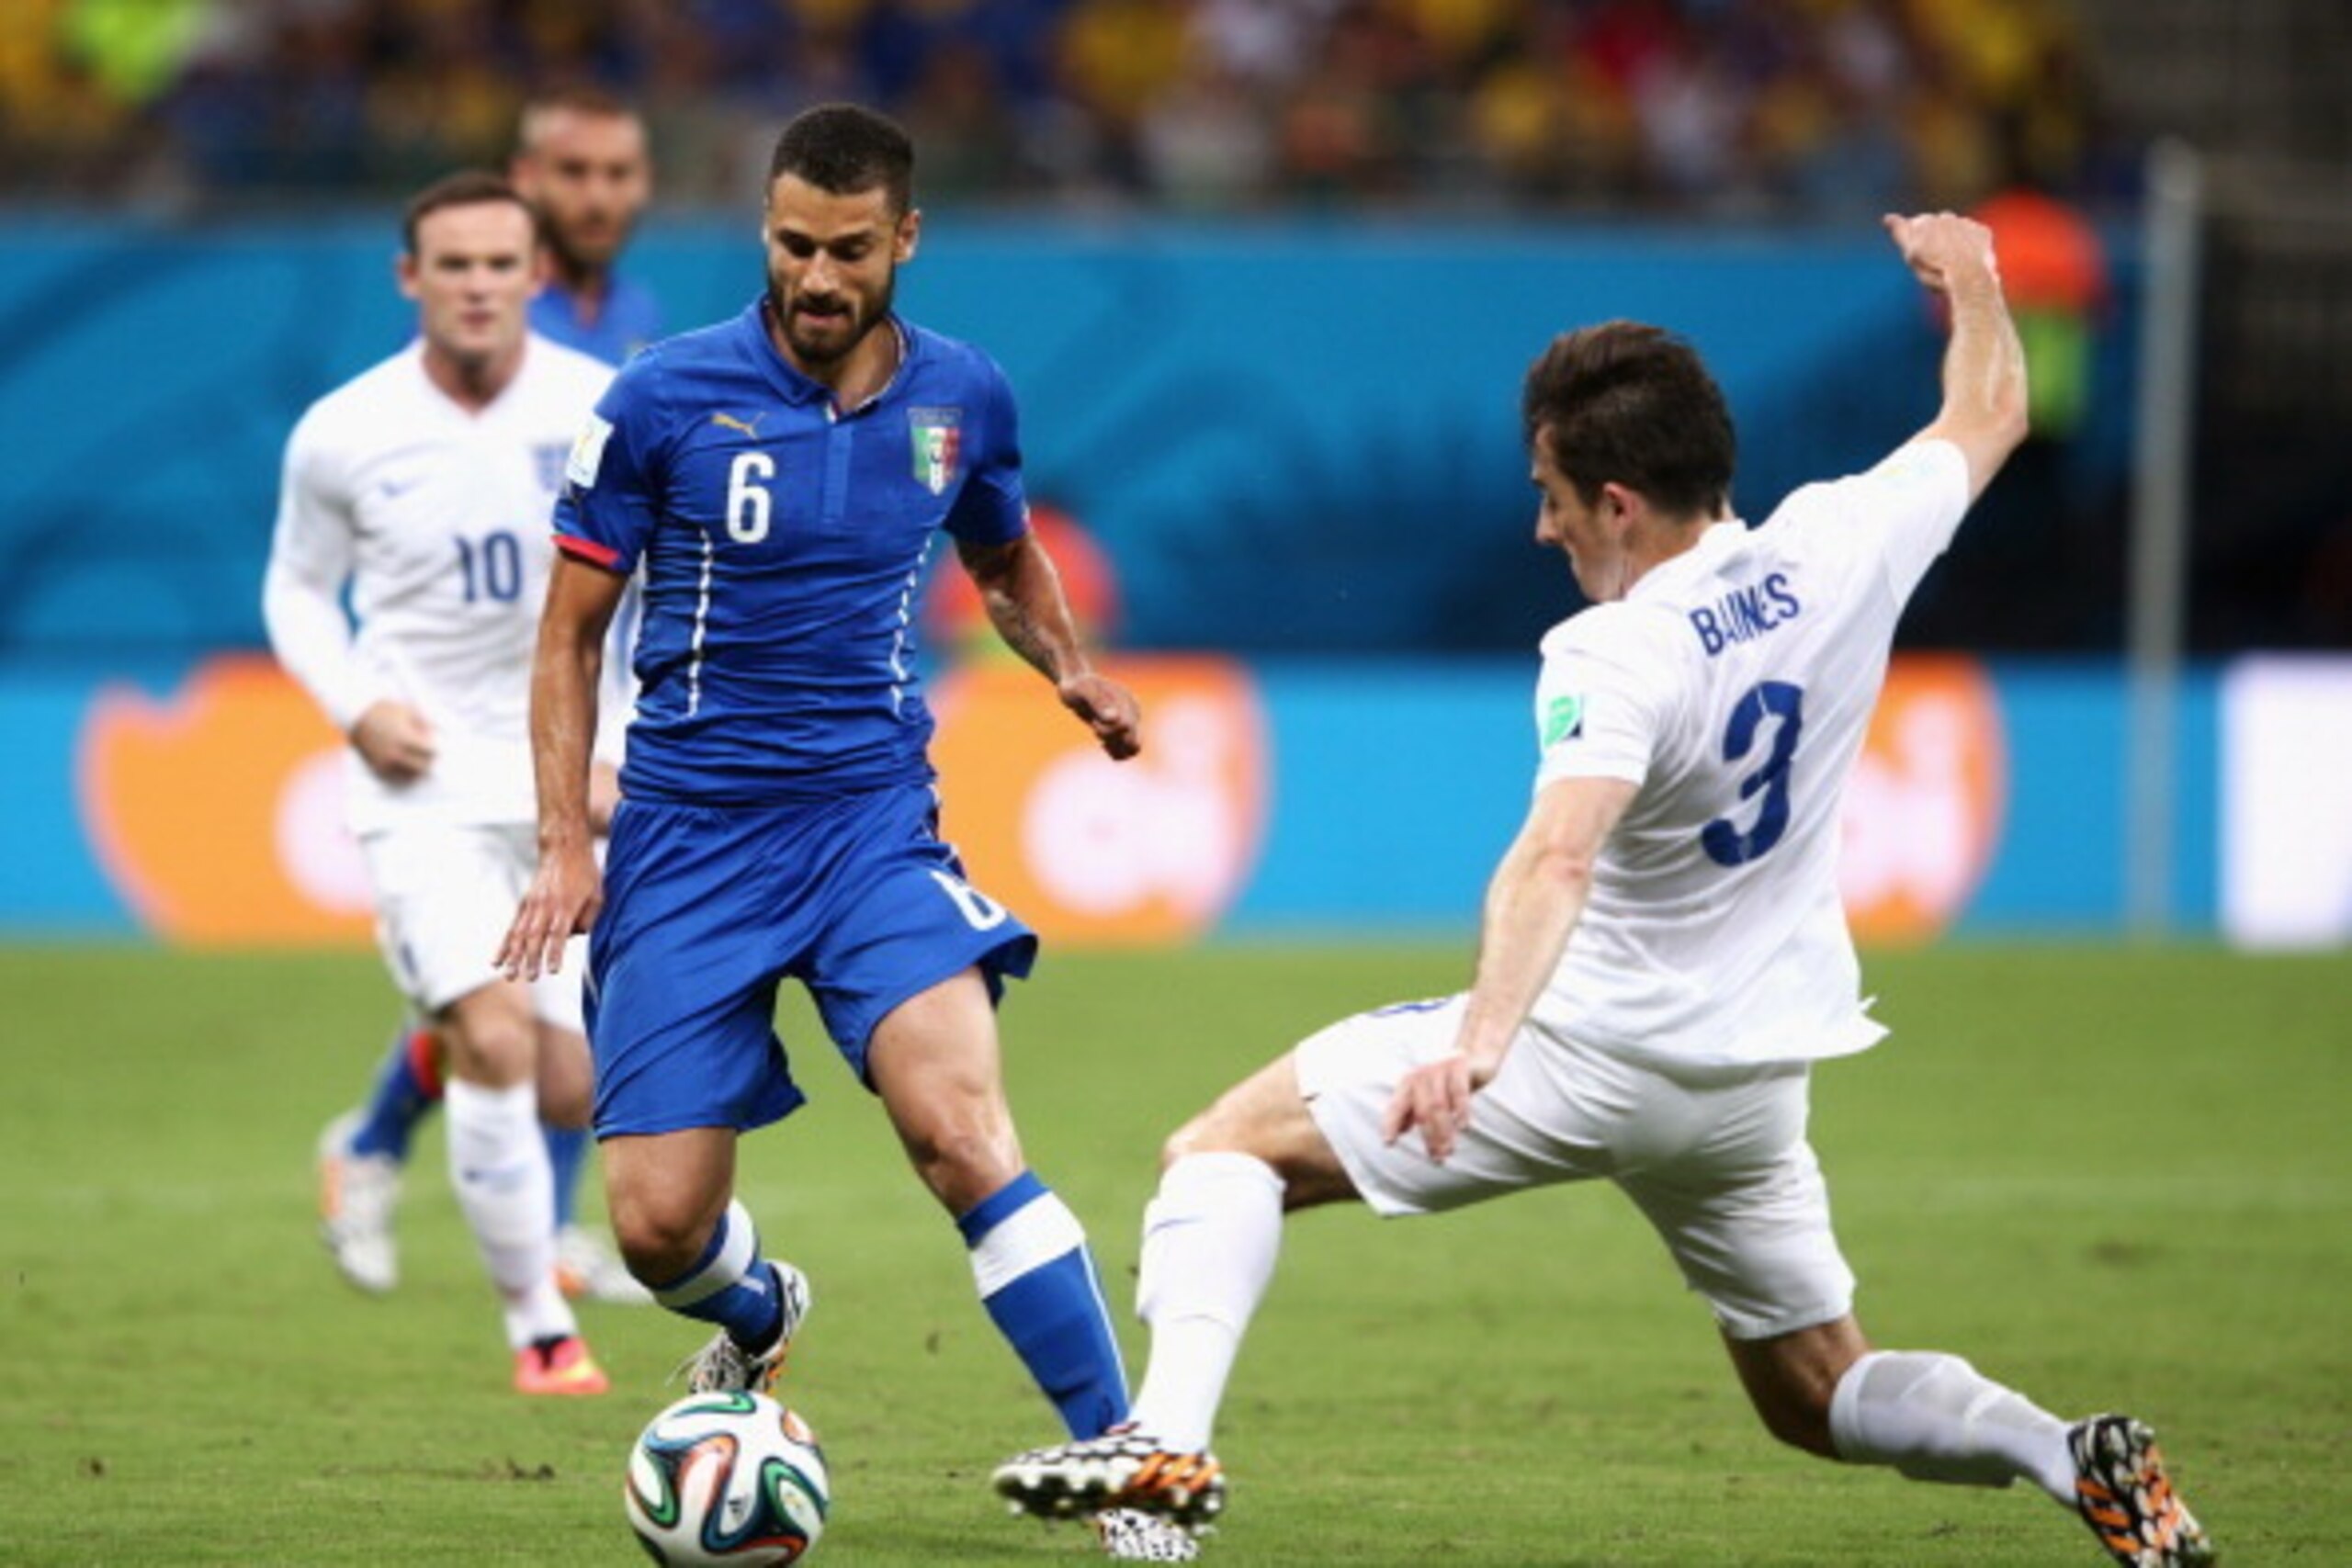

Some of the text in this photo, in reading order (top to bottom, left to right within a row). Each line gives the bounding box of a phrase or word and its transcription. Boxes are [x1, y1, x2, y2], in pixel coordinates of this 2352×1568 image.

[726, 451, 775, 545] 6
[454, 530, 521, 604] 10
[1701, 680, 1804, 867] 3
